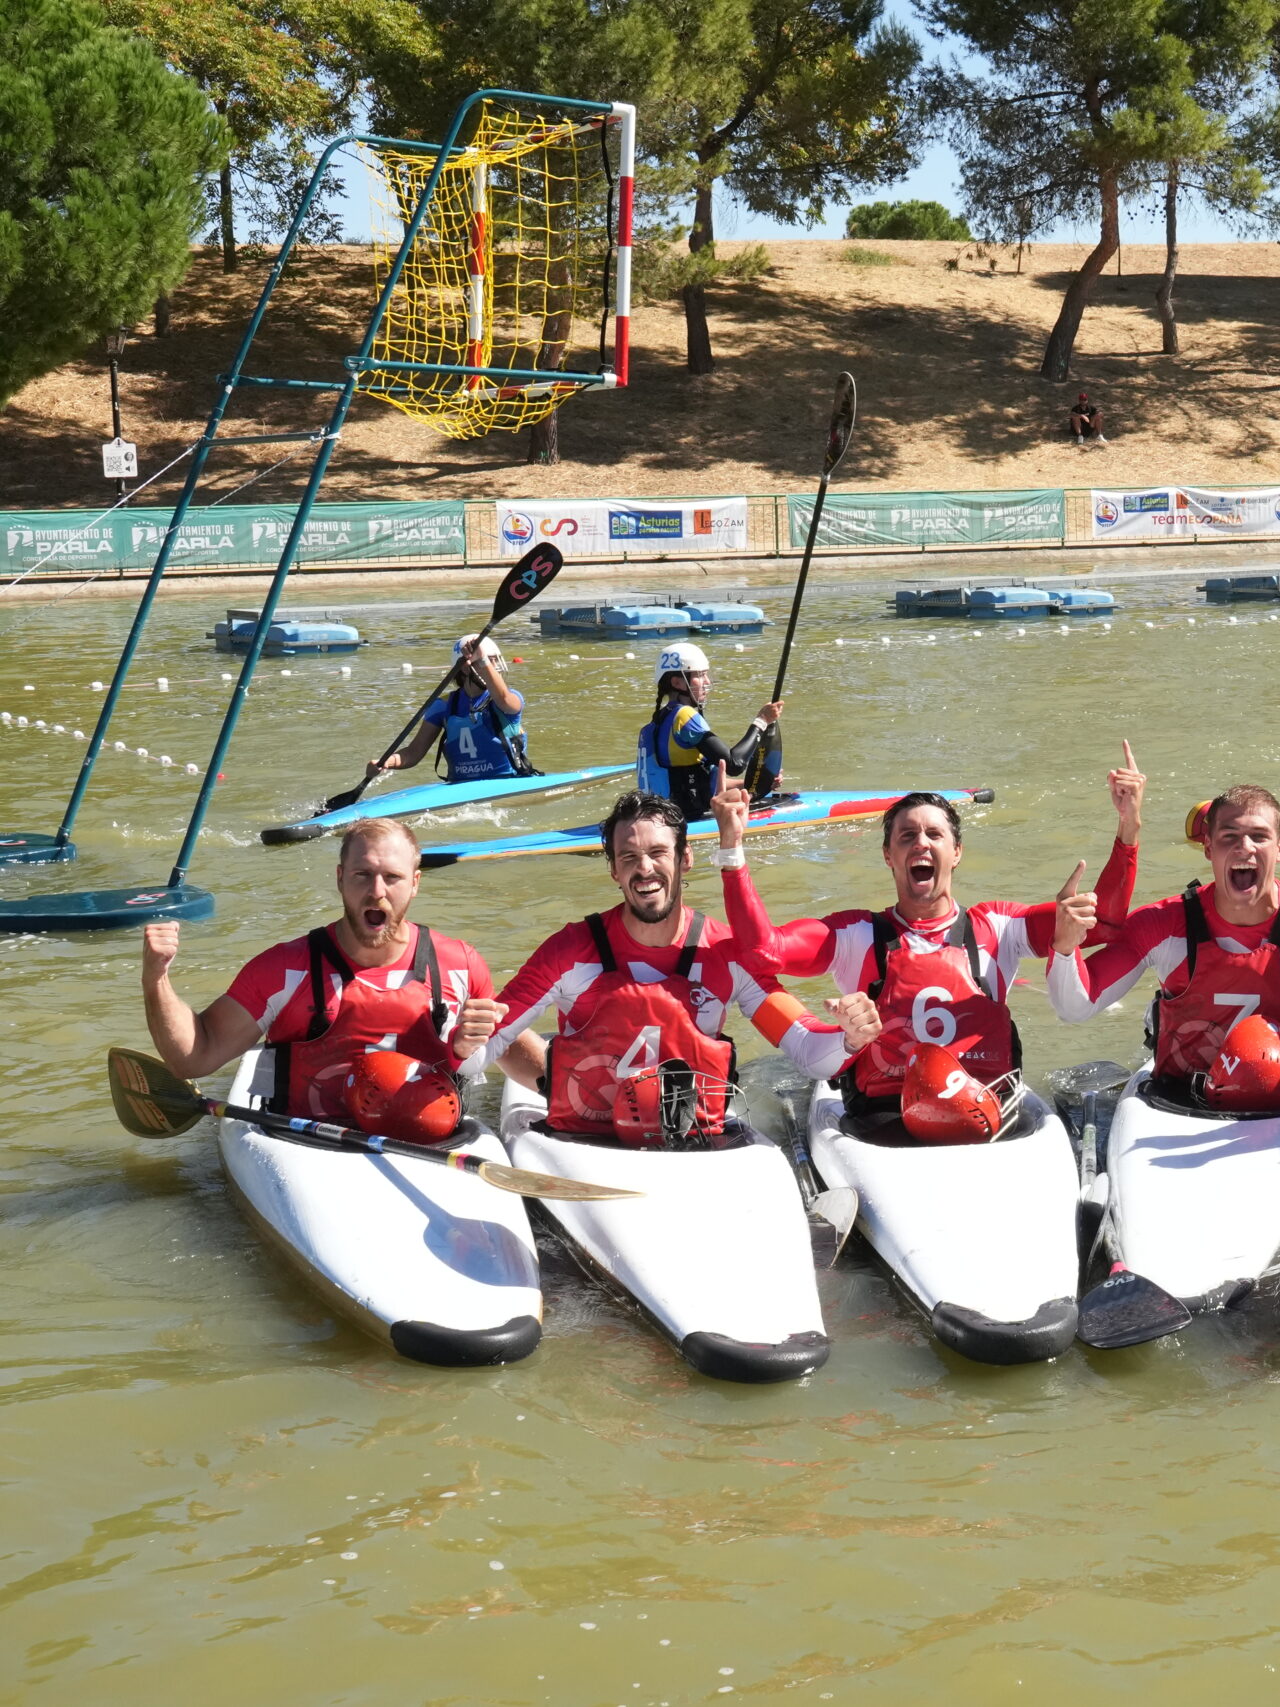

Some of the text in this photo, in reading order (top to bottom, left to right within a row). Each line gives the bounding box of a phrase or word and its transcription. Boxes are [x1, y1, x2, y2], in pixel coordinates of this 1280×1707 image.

[341, 521, 351, 531] DE
[639, 516, 680, 526] Asturias
[912, 518, 970, 530] PARLA
[1005, 513, 1059, 526] PARLA
[103, 528, 113, 538] DE
[159, 524, 234, 537] AYNTAMIENTO DE
[394, 527, 462, 541] PARLA
[279, 533, 350, 546] PARLA
[36, 540, 114, 554] PARLA
[509, 556, 554, 599] CPS
[661, 652, 681, 669] 23
[458, 727, 477, 758] 4
[455, 763, 494, 773] PIRAGUA
[912, 986, 957, 1047] 6
[1214, 993, 1260, 1040] 7
[616, 1025, 661, 1079] 4
[1103, 1274, 1136, 1289] EVO
